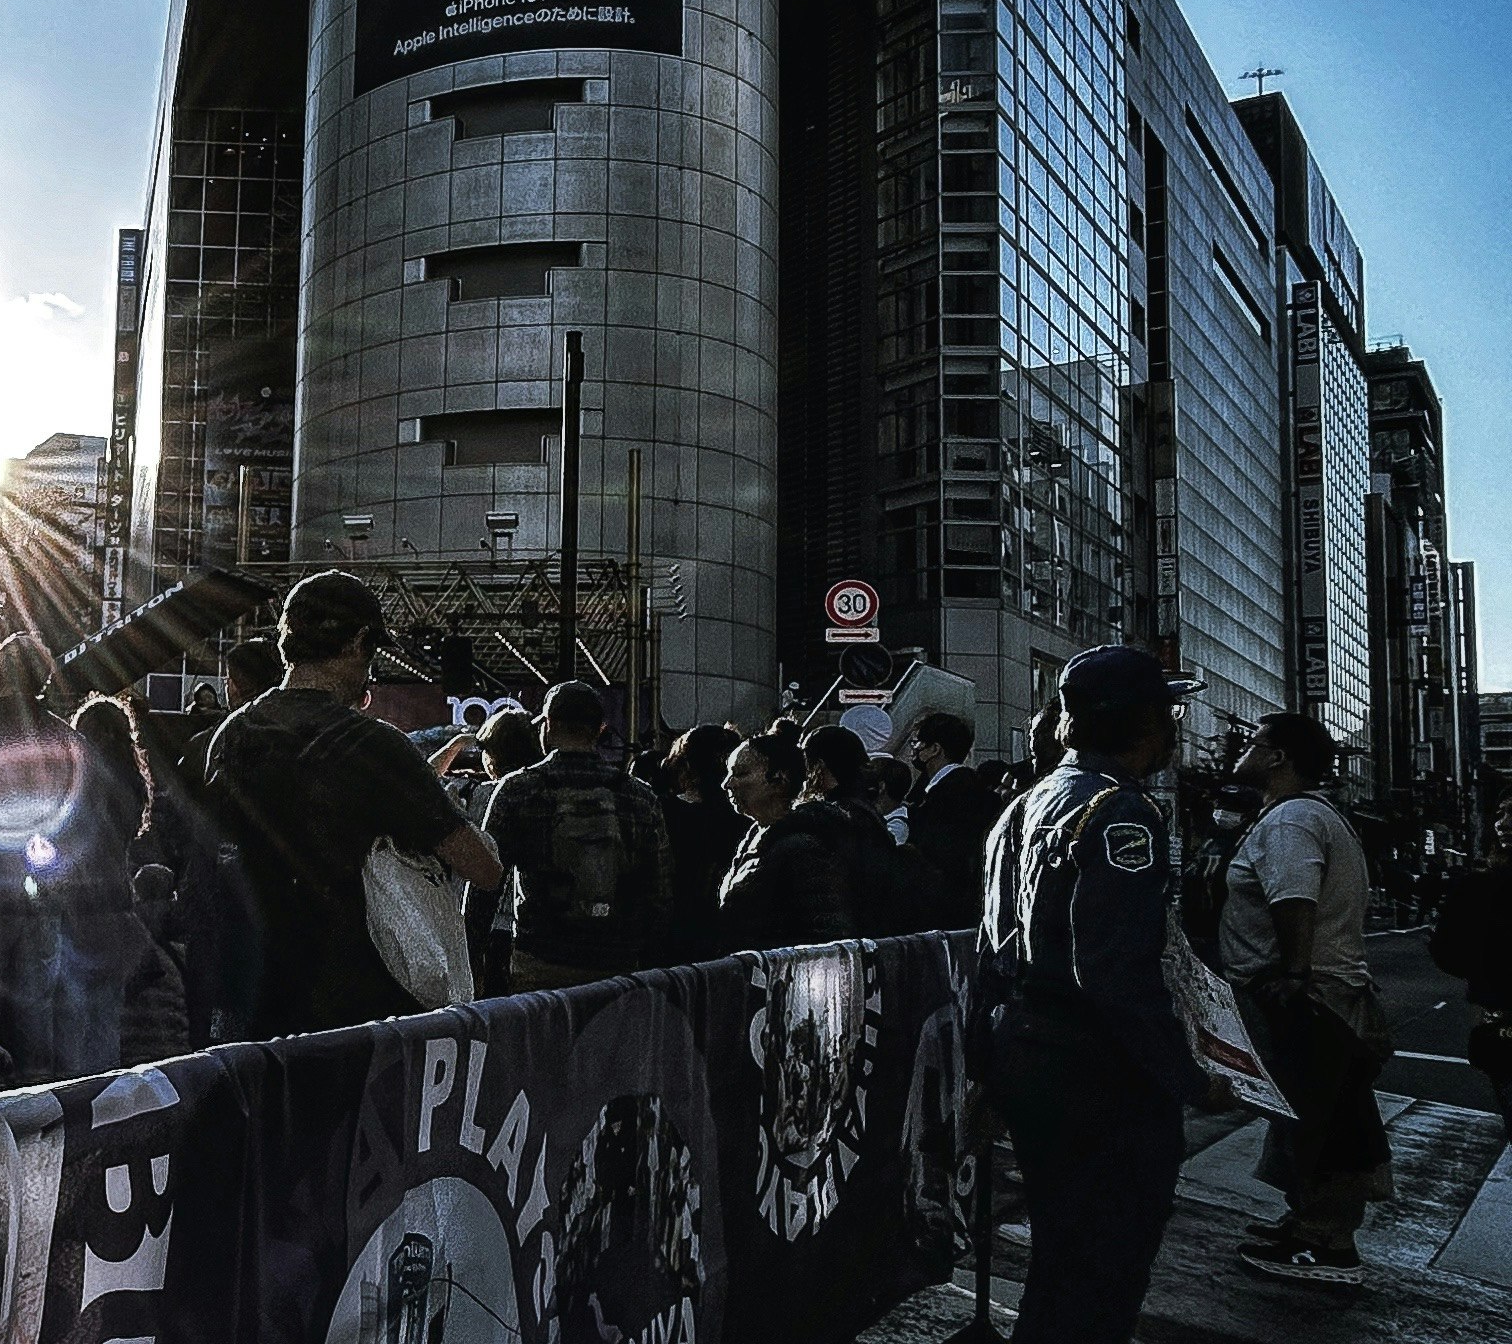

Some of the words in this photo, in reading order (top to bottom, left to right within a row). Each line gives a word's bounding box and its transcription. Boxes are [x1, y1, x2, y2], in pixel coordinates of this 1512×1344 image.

[393, 29, 436, 56] Apple
[1297, 308, 1320, 360] LABI
[1303, 498, 1323, 575] SHIBUYA
[838, 593, 867, 614] 30
[1304, 642, 1327, 697] LABI
